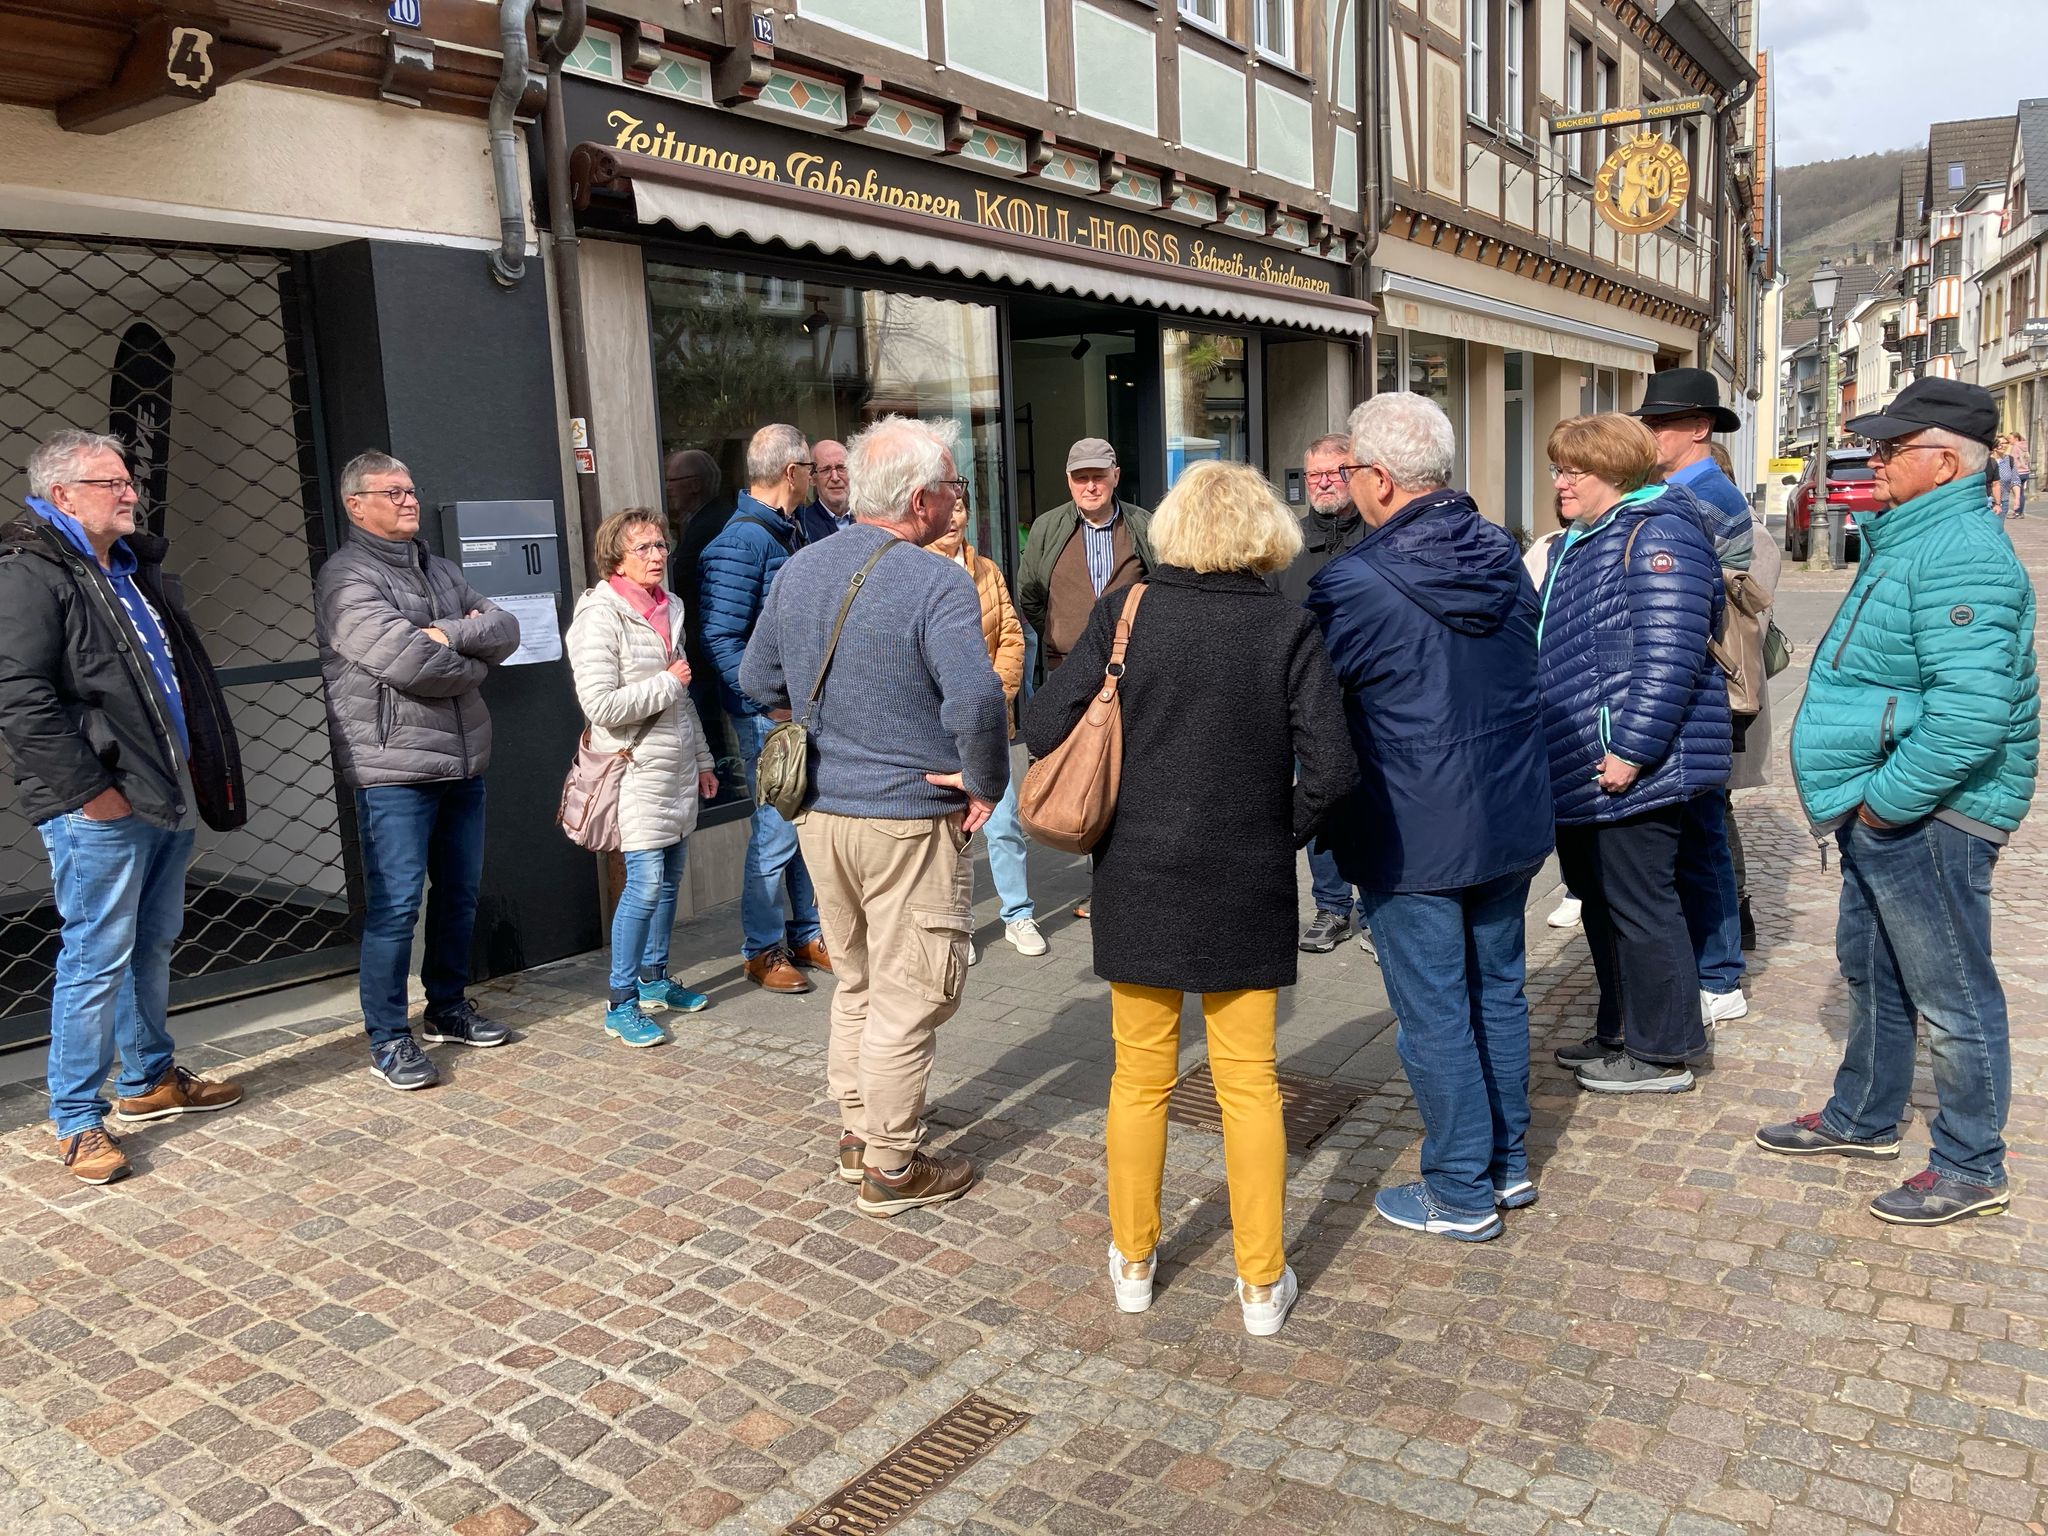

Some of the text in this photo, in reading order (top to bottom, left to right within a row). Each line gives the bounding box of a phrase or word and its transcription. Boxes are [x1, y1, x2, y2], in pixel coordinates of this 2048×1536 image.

[393, 0, 416, 22] 10
[757, 18, 772, 41] 12
[170, 32, 206, 82] 4
[607, 110, 781, 182] Zeitungen
[786, 152, 963, 220] Tabakwaren
[1657, 142, 1689, 207] BERLIN
[521, 543, 542, 575] 10
